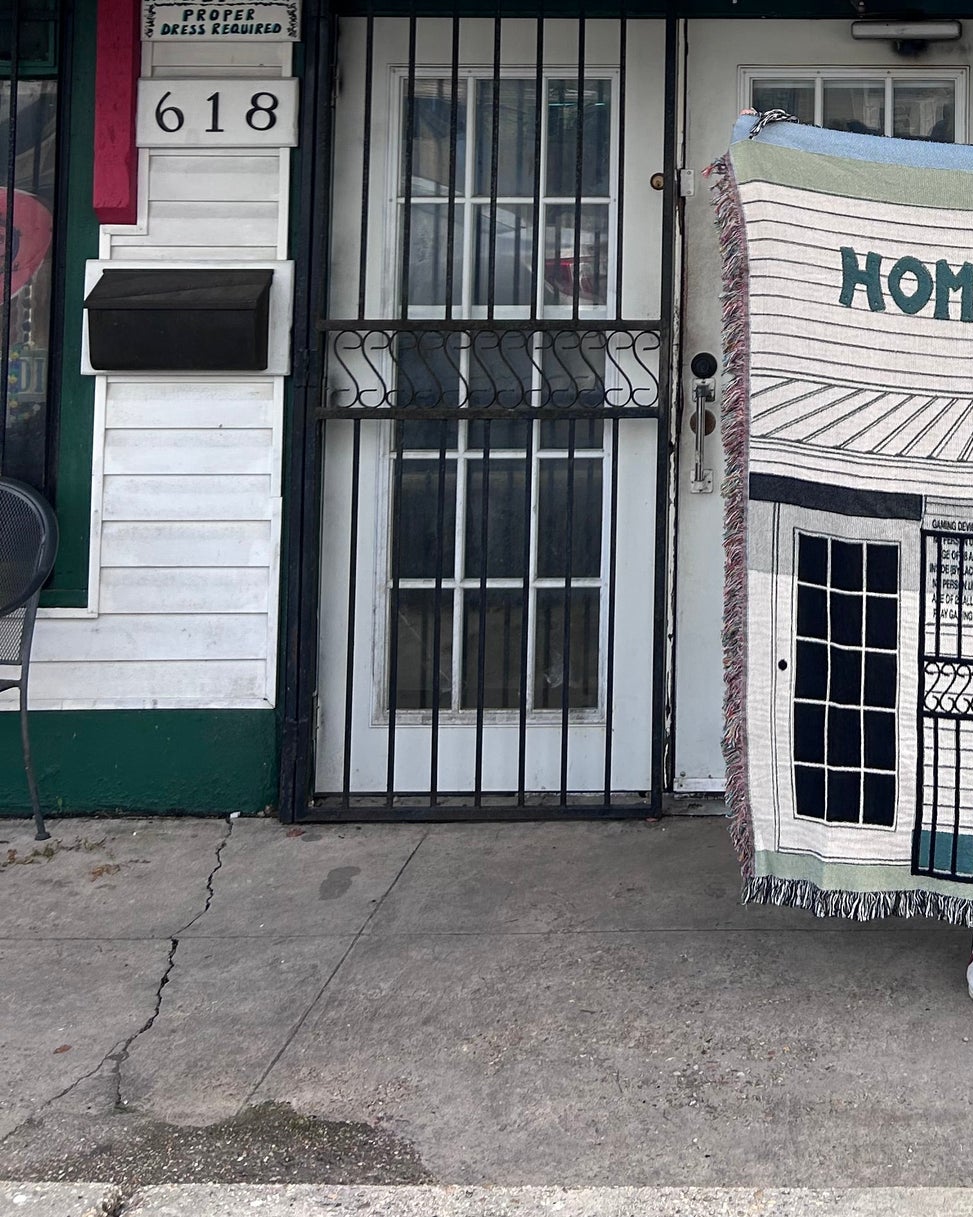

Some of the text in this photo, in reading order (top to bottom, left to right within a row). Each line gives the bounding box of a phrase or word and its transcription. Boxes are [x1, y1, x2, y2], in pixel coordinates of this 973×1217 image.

[182, 9, 255, 22] PROPER
[160, 23, 282, 35] DRESS REQUIRED
[155, 91, 279, 133] 618
[932, 519, 957, 531] GAMING
